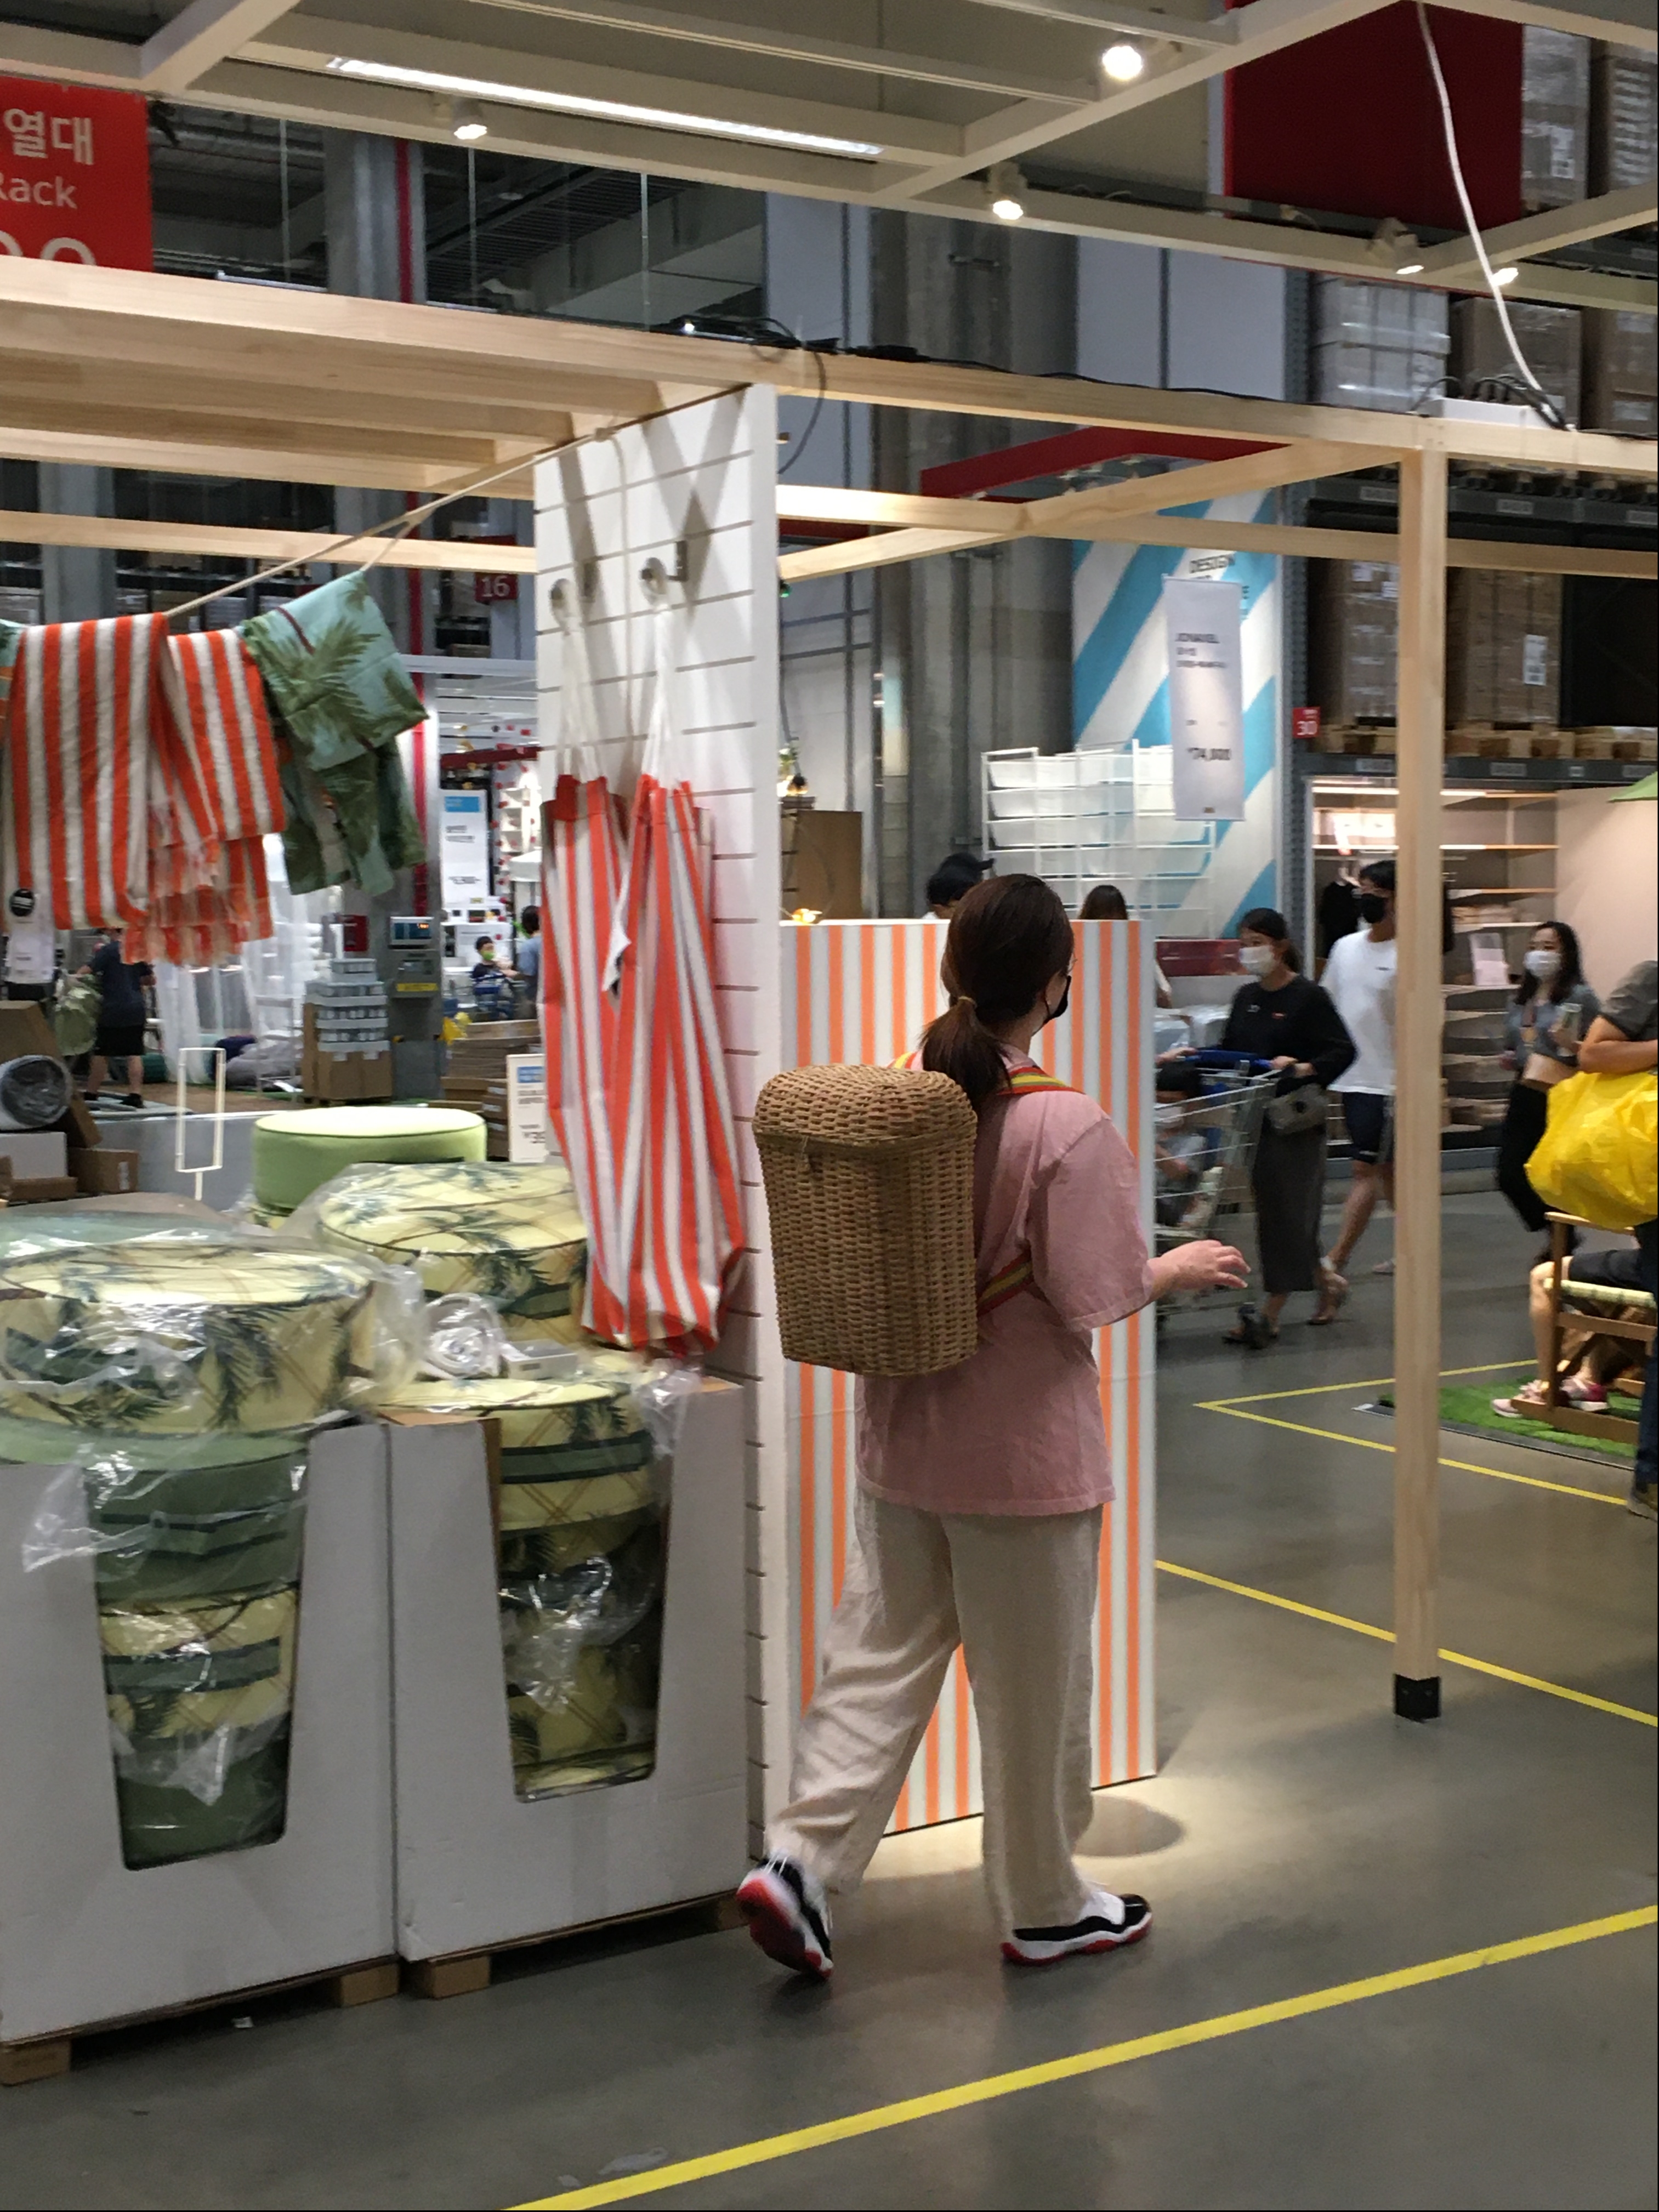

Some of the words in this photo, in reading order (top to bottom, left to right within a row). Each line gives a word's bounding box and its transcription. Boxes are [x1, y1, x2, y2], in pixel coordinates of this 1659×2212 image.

[1189, 554, 1236, 573] DESIGN
[482, 575, 510, 598] 16
[1297, 721, 1317, 736] 30
